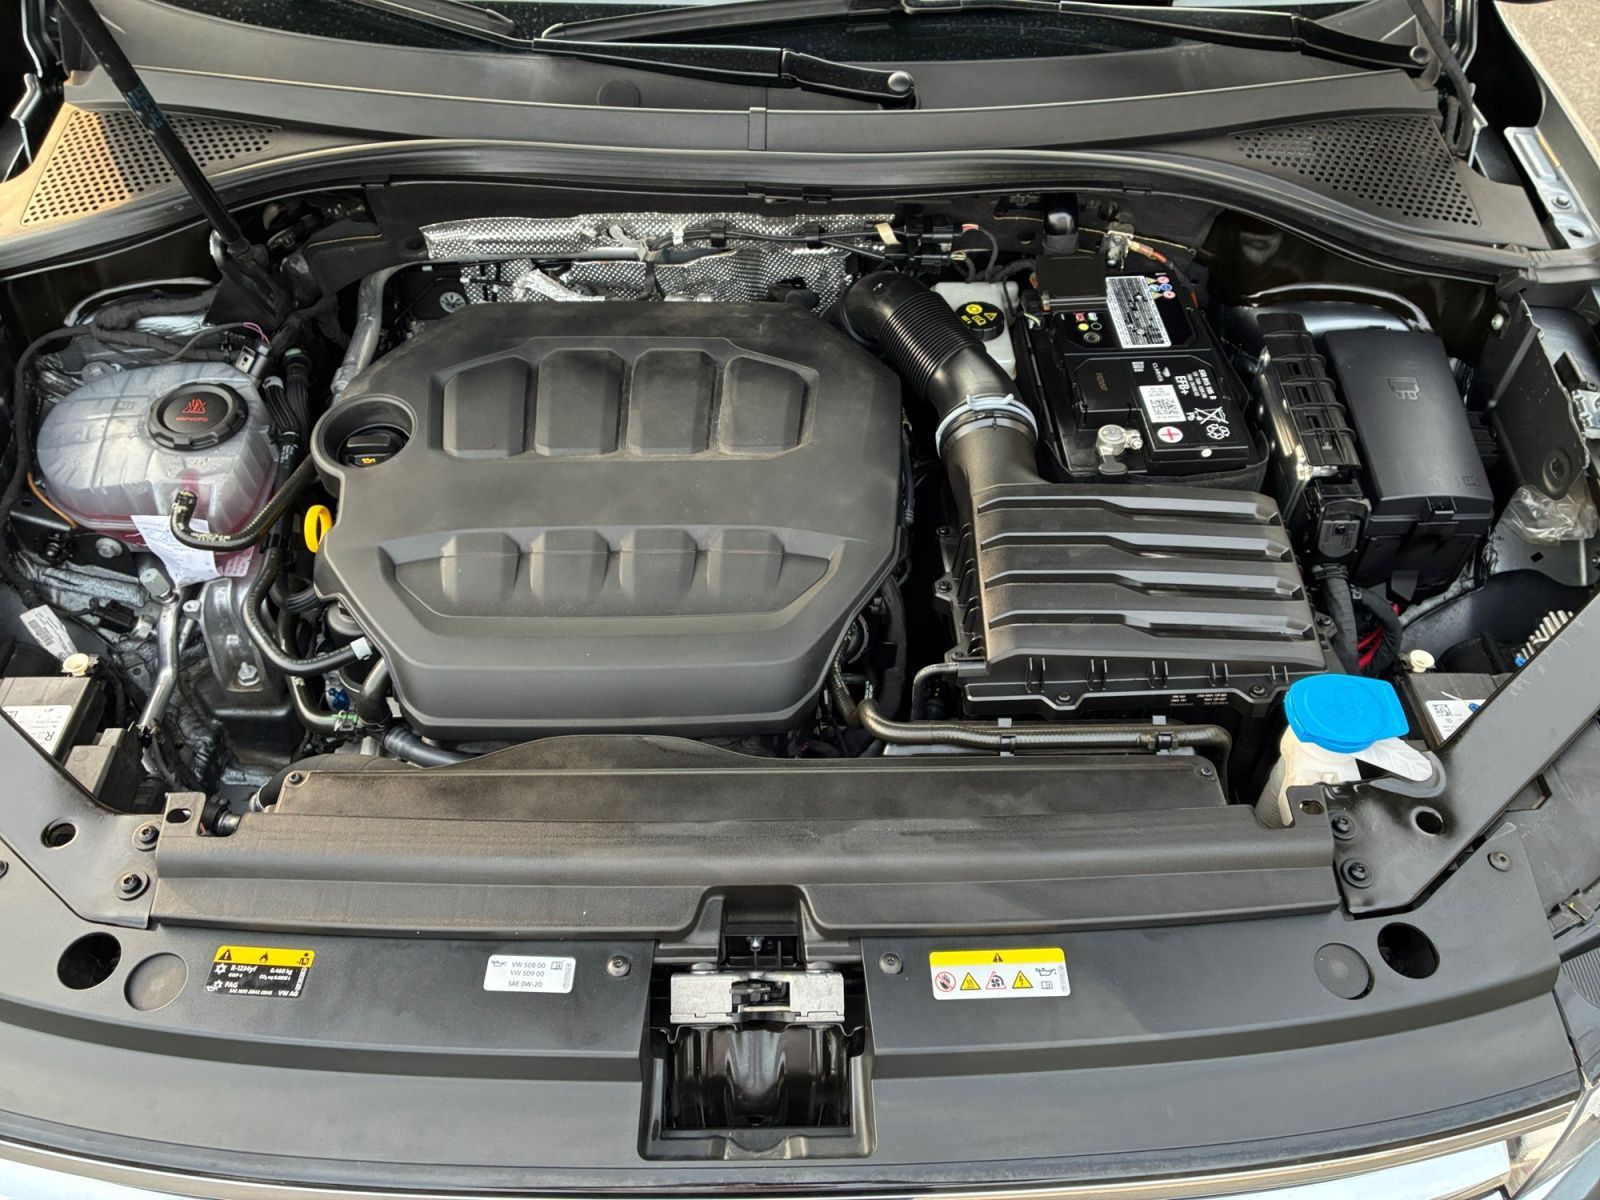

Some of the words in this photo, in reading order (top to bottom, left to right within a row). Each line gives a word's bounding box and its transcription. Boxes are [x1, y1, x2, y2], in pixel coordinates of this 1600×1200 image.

[1175, 375, 1190, 395] EFB+
[524, 961, 536, 969] 508
[230, 965, 258, 974] R-1234yf
[510, 969, 521, 977] VW
[224, 981, 239, 989] PAG
[521, 980, 543, 988] 0W-20
